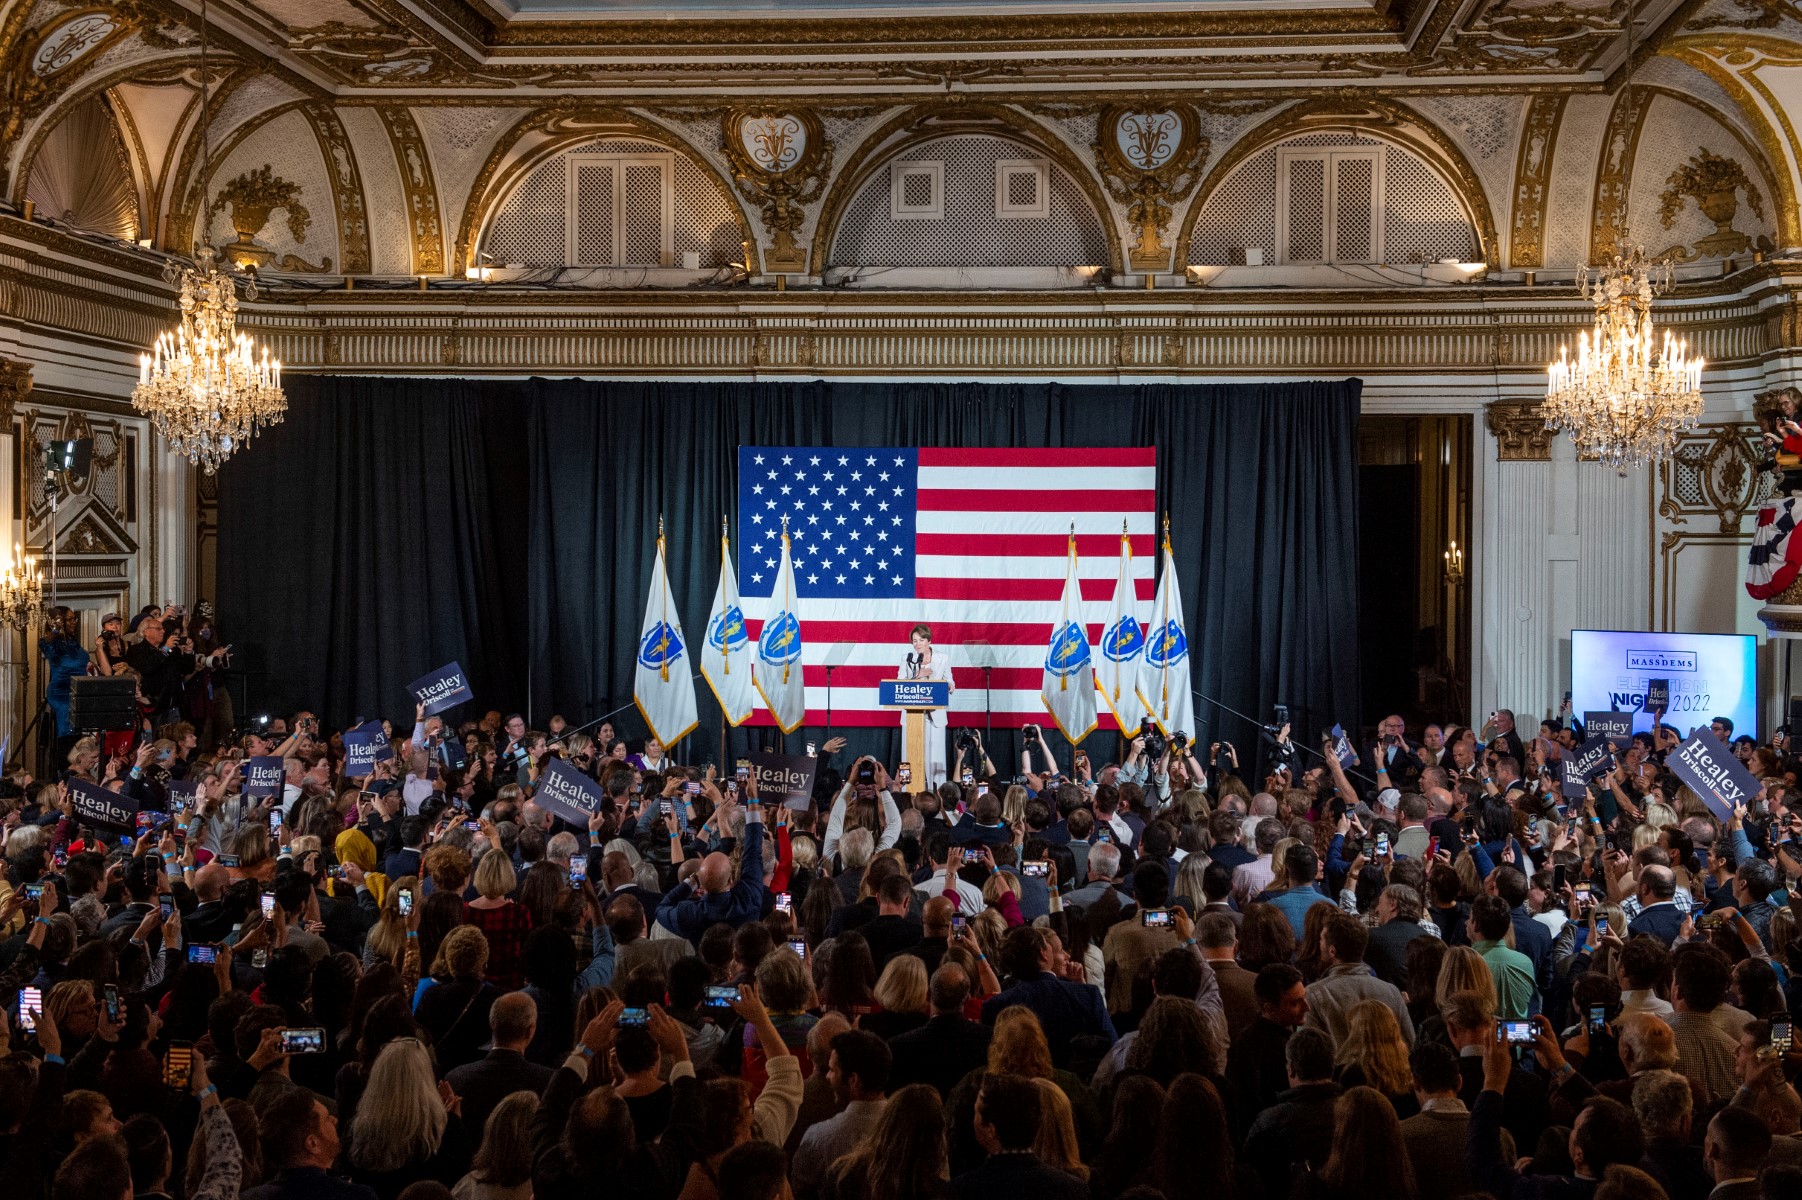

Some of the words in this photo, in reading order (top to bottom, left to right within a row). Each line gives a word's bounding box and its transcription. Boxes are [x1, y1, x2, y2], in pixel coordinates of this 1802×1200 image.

[1631, 658, 1693, 668] MASSDEMS
[416, 673, 460, 700] Healey
[894, 683, 934, 696] Healey
[1617, 676, 1708, 693] ELETION
[1613, 693, 1648, 706] NIG
[1672, 694, 1711, 712] 2022
[1587, 720, 1630, 734] Healey
[1679, 750, 1717, 790] Driscoll
[1687, 738, 1745, 800] Healey
[543, 784, 579, 809] Driscoll
[547, 770, 598, 810] Healey
[757, 781, 788, 794] iscoll
[72, 789, 132, 822] Healey
